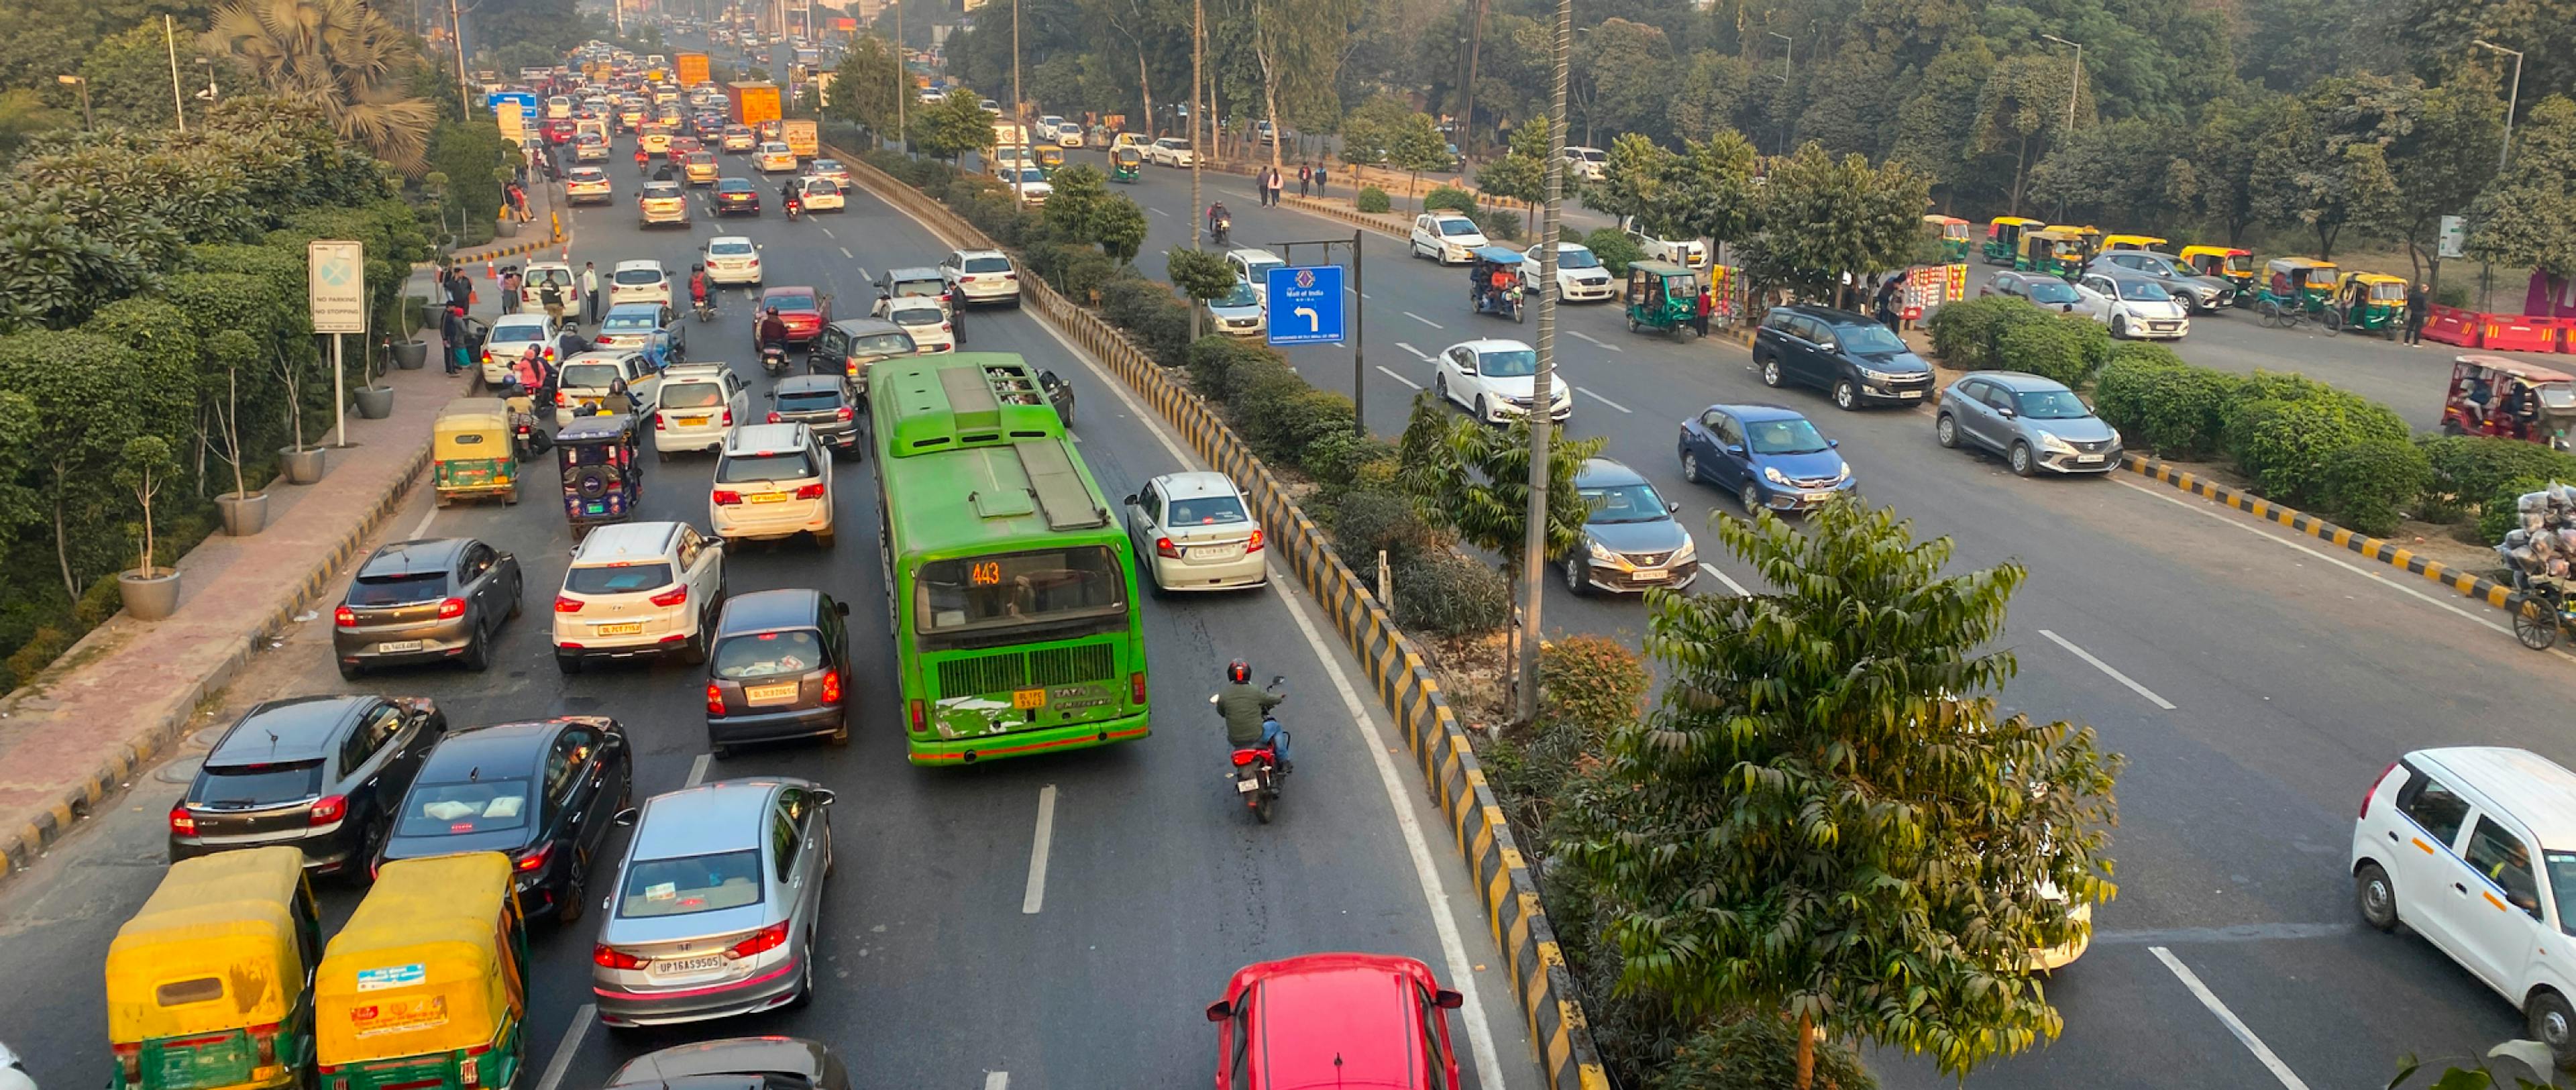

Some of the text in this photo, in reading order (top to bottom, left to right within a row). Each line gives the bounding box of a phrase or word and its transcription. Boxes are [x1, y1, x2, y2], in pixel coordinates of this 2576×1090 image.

[973, 562, 999, 585] 443
[1055, 687, 1085, 698] TATA
[660, 957, 718, 972] UP16AS9505
